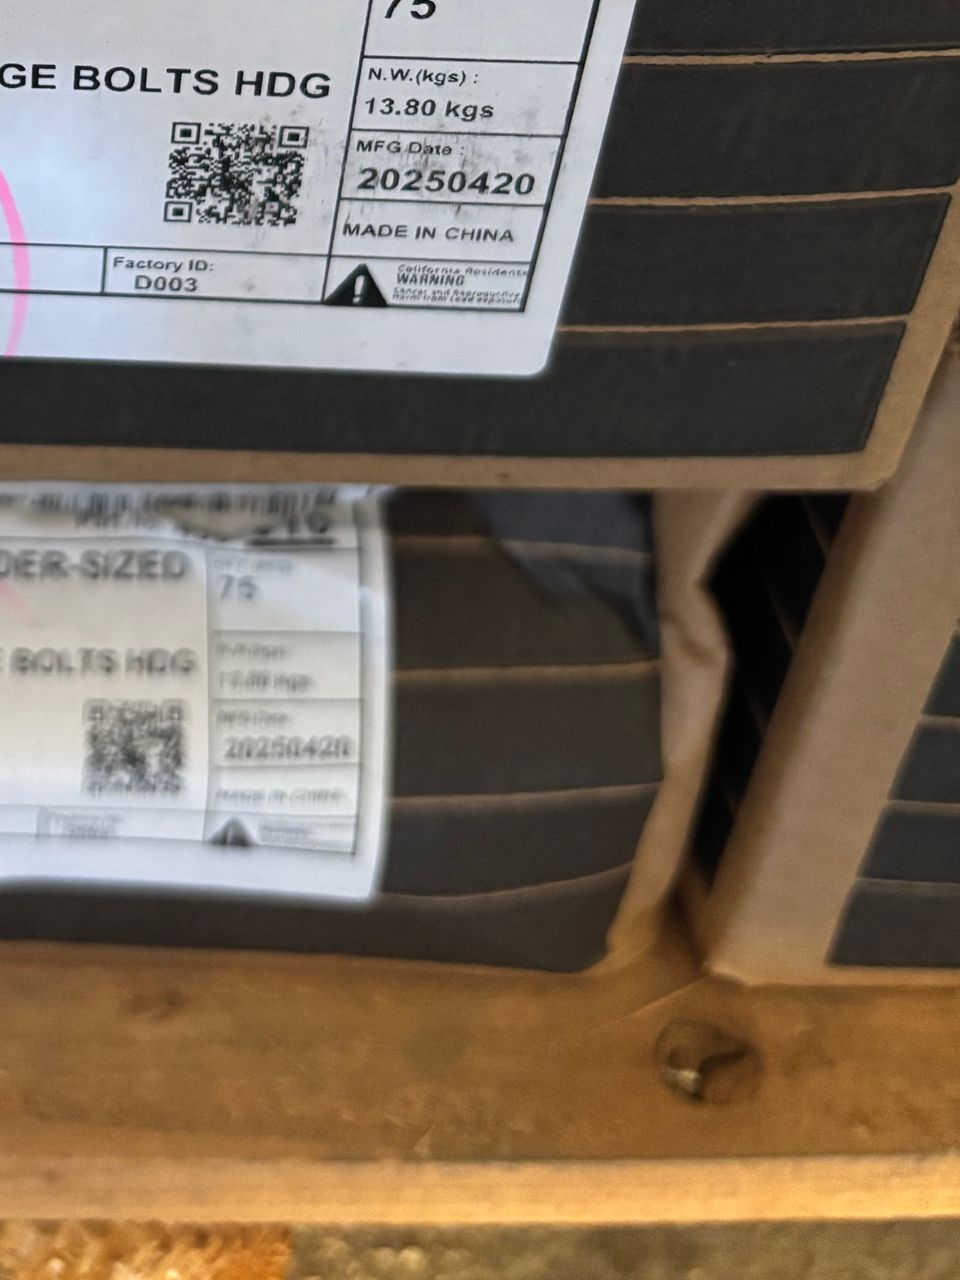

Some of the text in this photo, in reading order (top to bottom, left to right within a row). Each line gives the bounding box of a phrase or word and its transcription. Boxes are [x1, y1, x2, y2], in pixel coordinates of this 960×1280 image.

[73, 65, 220, 96] BOLTS
[235, 70, 332, 99] HDG
[364, 97, 495, 121] 13.80 kgs
[356, 139, 402, 154] MFG
[408, 142, 453, 156] Date
[356, 167, 536, 196] 20250420
[343, 223, 514, 243] MADE IN CHINA
[113, 256, 215, 273] Factory ID:
[134, 274, 198, 292] D003
[396, 273, 465, 286] WARNING
[219, 575, 259, 601] 75
[10, 647, 118, 676] BOLTS
[124, 647, 198, 677] HDG
